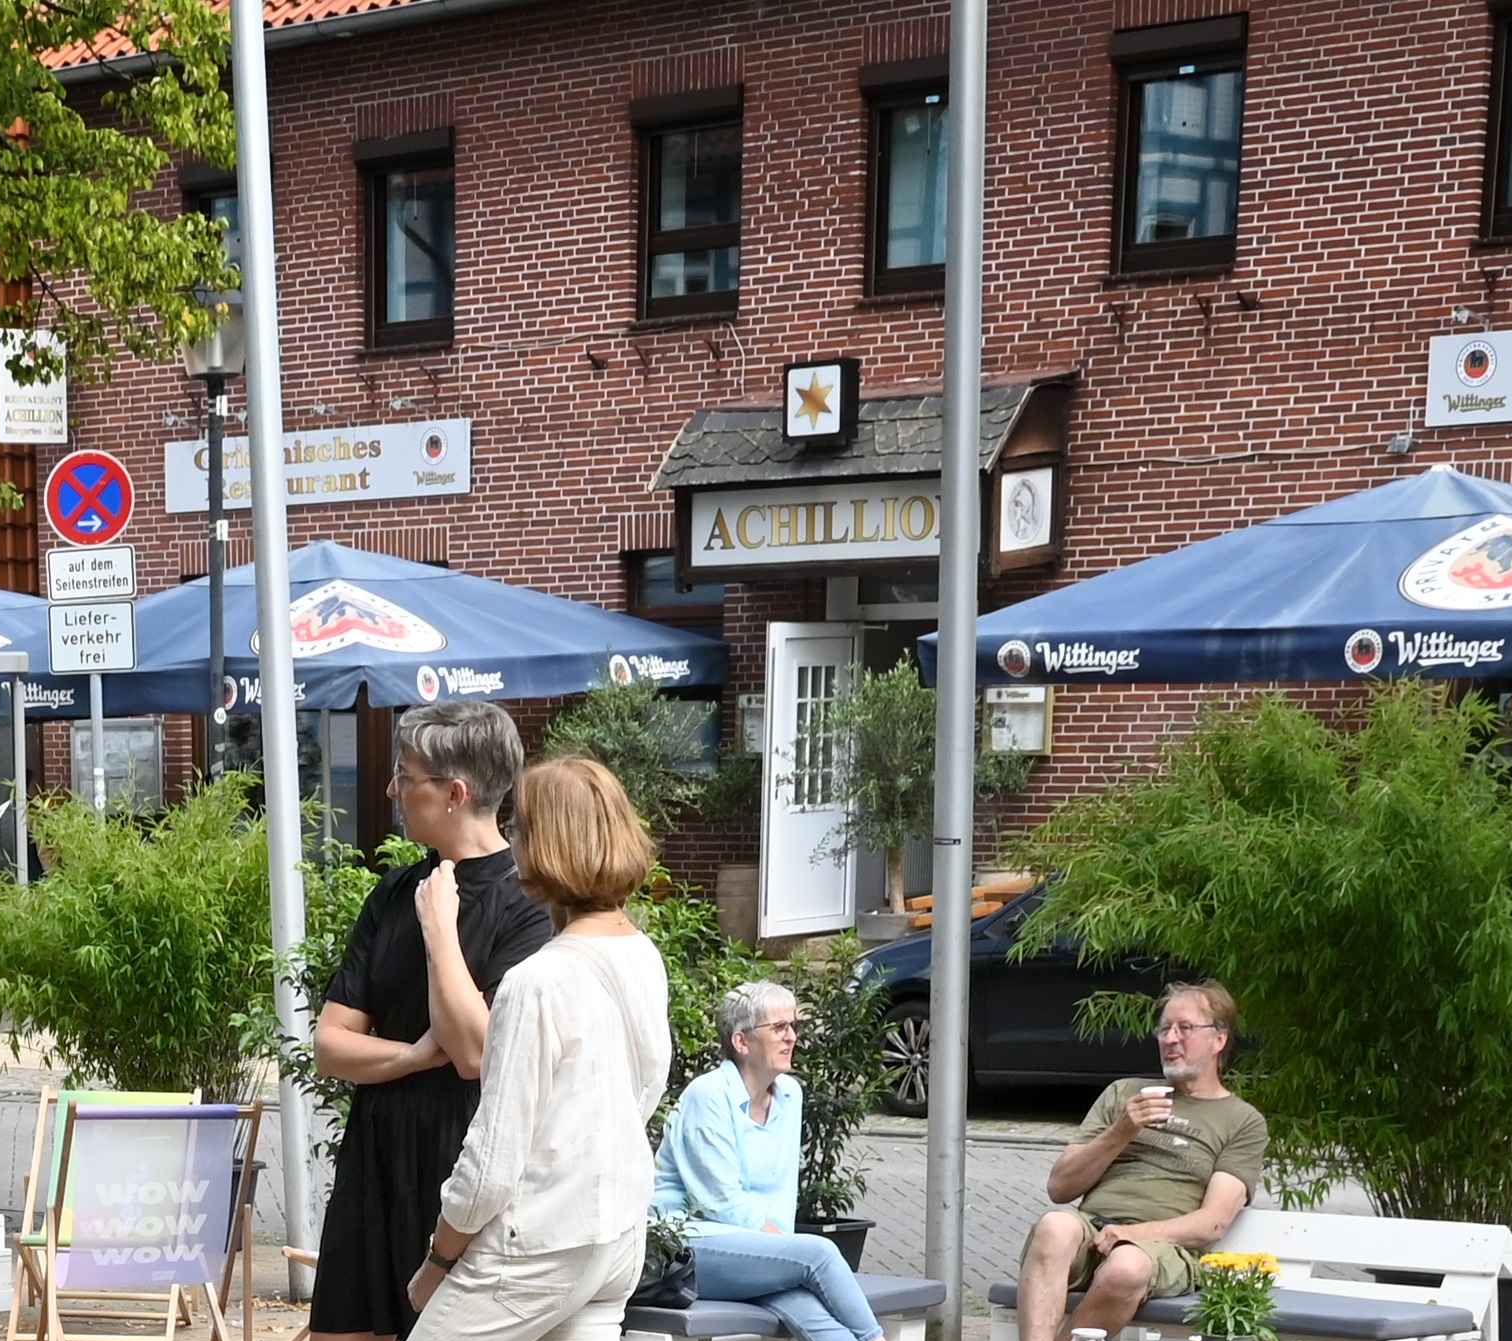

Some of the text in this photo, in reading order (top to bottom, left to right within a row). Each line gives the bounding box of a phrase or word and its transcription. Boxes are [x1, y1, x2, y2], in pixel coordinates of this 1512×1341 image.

[5, 395, 63, 405] RESTAURANT
[1442, 394, 1507, 413] Wittinger
[5, 409, 63, 422] ACHILLION
[205, 467, 371, 502] esurant
[412, 470, 456, 487] Wittinger
[68, 557, 114, 573] auf dem
[55, 574, 129, 592] Seitenstreifen
[64, 611, 117, 626] Liefer-
[61, 630, 122, 646] verkehr
[79, 649, 106, 664] frei
[1388, 630, 1505, 668] Wittinger
[1035, 642, 1140, 676] Wittinger
[438, 666, 505, 695] Wittinger
[95, 1180, 211, 1206] WOW
[92, 1213, 208, 1239] WOW
[91, 1243, 205, 1266] WOW
